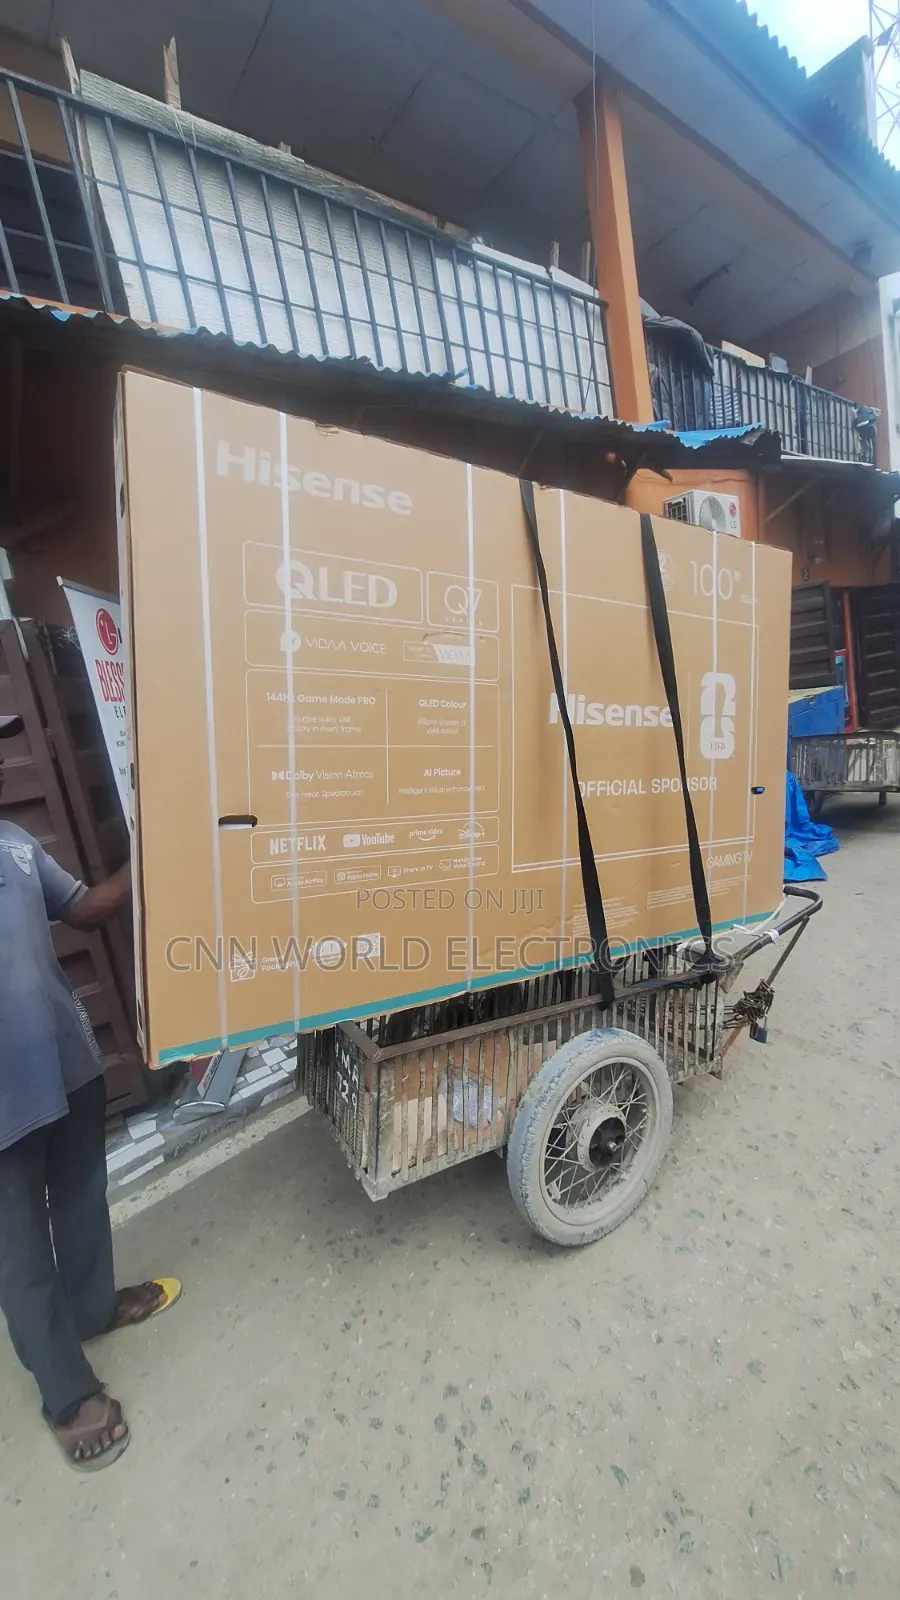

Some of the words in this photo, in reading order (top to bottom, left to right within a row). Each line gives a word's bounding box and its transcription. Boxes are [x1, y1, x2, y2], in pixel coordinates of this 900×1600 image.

[215, 439, 413, 517] Hisense
[275, 559, 398, 609] QLED
[444, 584, 482, 616] Q7
[349, 640, 387, 655] VOICE
[297, 694, 328, 704] Game
[329, 695, 356, 705] Mode
[357, 697, 376, 706] PRO
[418, 699, 439, 708] QLED
[440, 700, 467, 709] Colour
[549, 692, 674, 728] Hisense
[320, 727, 339, 735] every
[340, 725, 362, 734] frame
[433, 767, 462, 777] Picture
[361, 832, 396, 846] YouTube
[409, 829, 427, 839] prime
[427, 828, 444, 836] video
[269, 834, 327, 856] NETFLIX
[706, 853, 742, 870] GAMING
